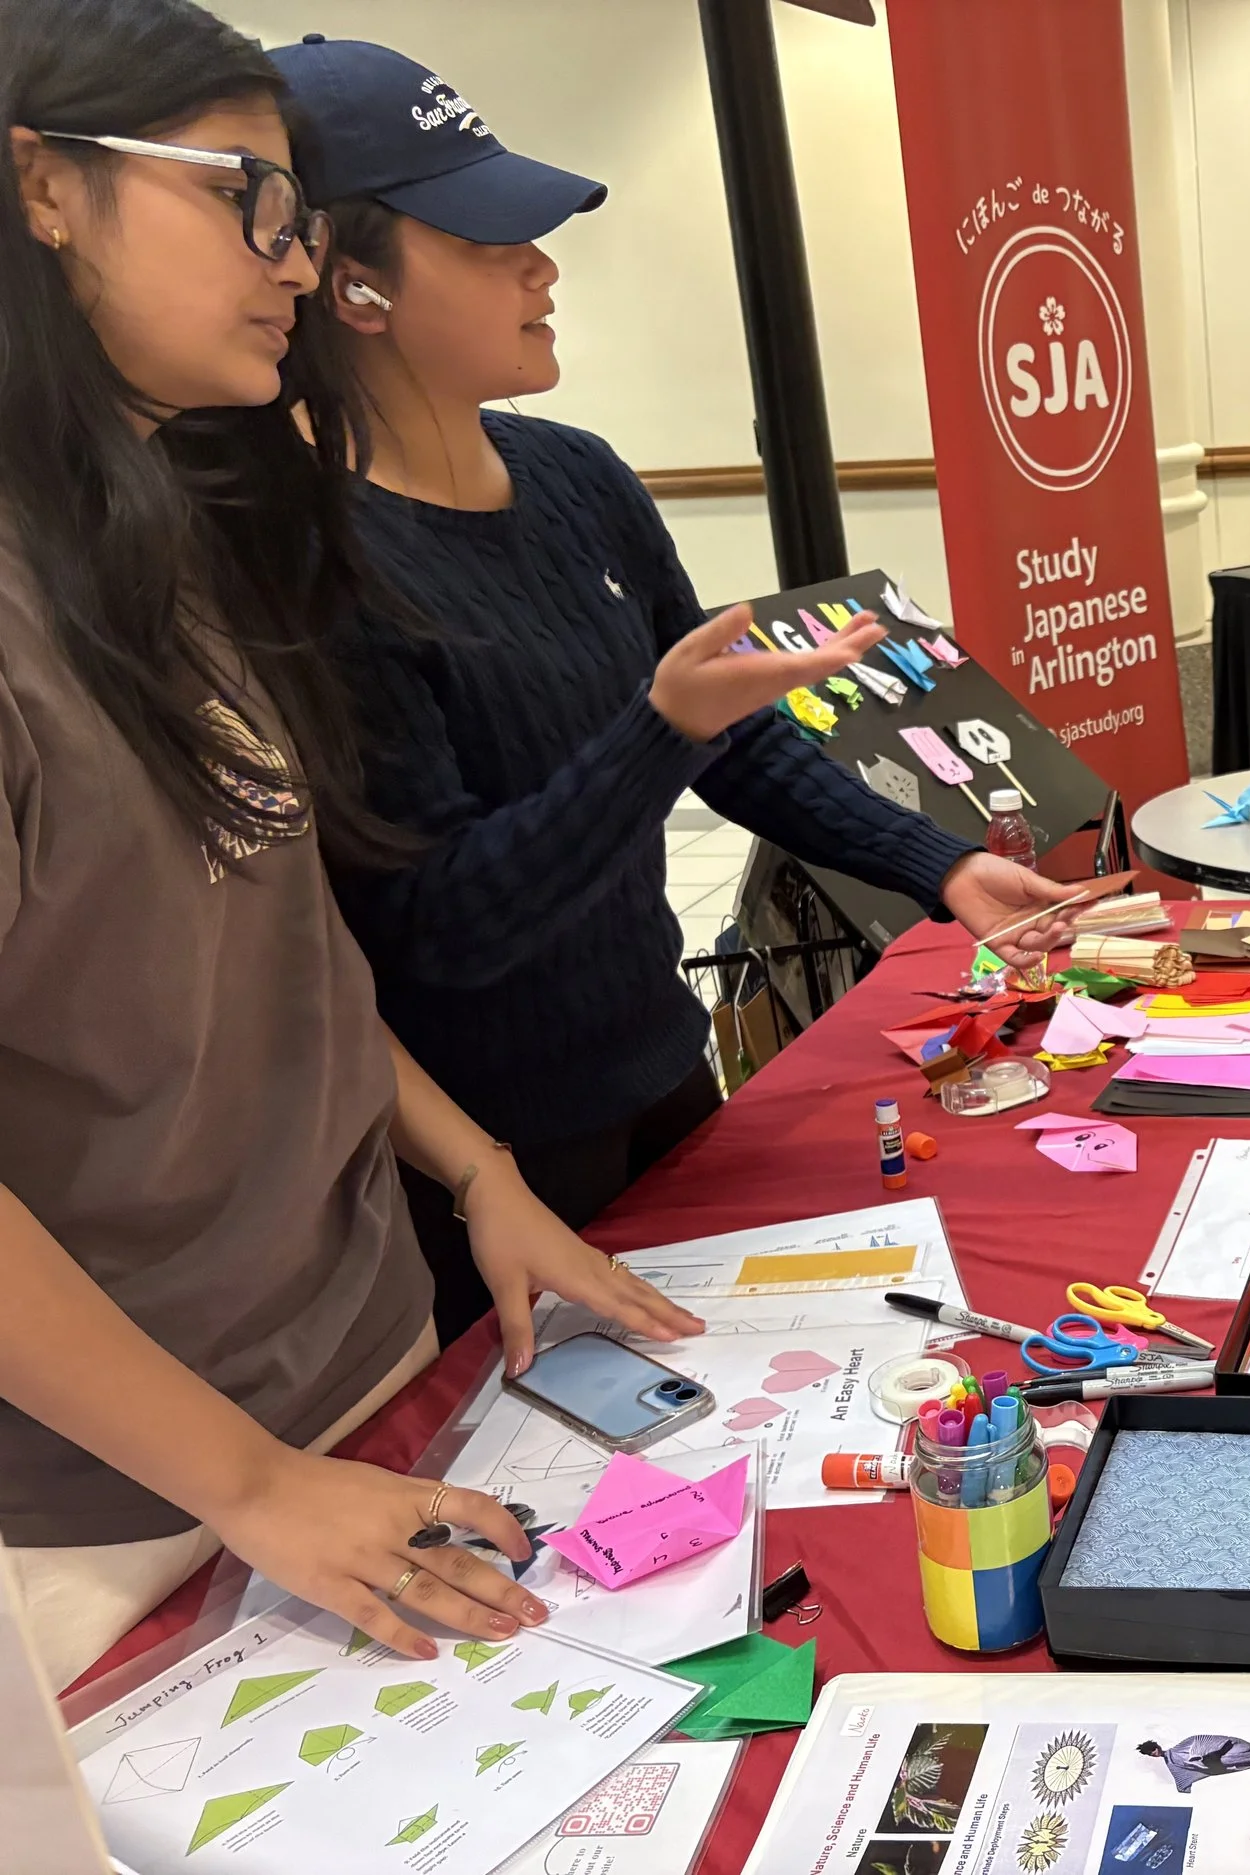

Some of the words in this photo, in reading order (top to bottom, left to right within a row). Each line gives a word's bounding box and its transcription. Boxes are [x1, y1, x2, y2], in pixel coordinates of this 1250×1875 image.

[412, 106, 448, 131] San
[956, 176, 1022, 255] にほんご
[1032, 183, 1049, 204] de
[1056, 187, 1124, 255] つながる
[1006, 339, 1109, 418] SJA
[1016, 537, 1098, 589] Study
[1023, 586, 1148, 646] Japanese
[1011, 647, 1025, 666] in
[1029, 633, 1157, 694] Arlington
[1060, 704, 1144, 748] sjastudy.org
[843, 1348, 864, 1375] Heart
[1139, 1353, 1164, 1362] SJA
[834, 1378, 860, 1402] Easy
[830, 1405, 849, 1421] An
[106, 1678, 193, 1733] Jumping
[204, 1648, 246, 1674] Frog
[254, 1633, 267, 1645] 1
[865, 1733, 880, 1749] Life
[851, 1750, 873, 1782] Human
[846, 1783, 859, 1801] and
[974, 1793, 988, 1808] Life
[826, 1803, 851, 1840] Science
[998, 1803, 1010, 1820] Steps
[964, 1811, 983, 1841] Human
[846, 1829, 867, 1858] Nature
[960, 1844, 972, 1859] and
[954, 1861, 966, 1875] nce
